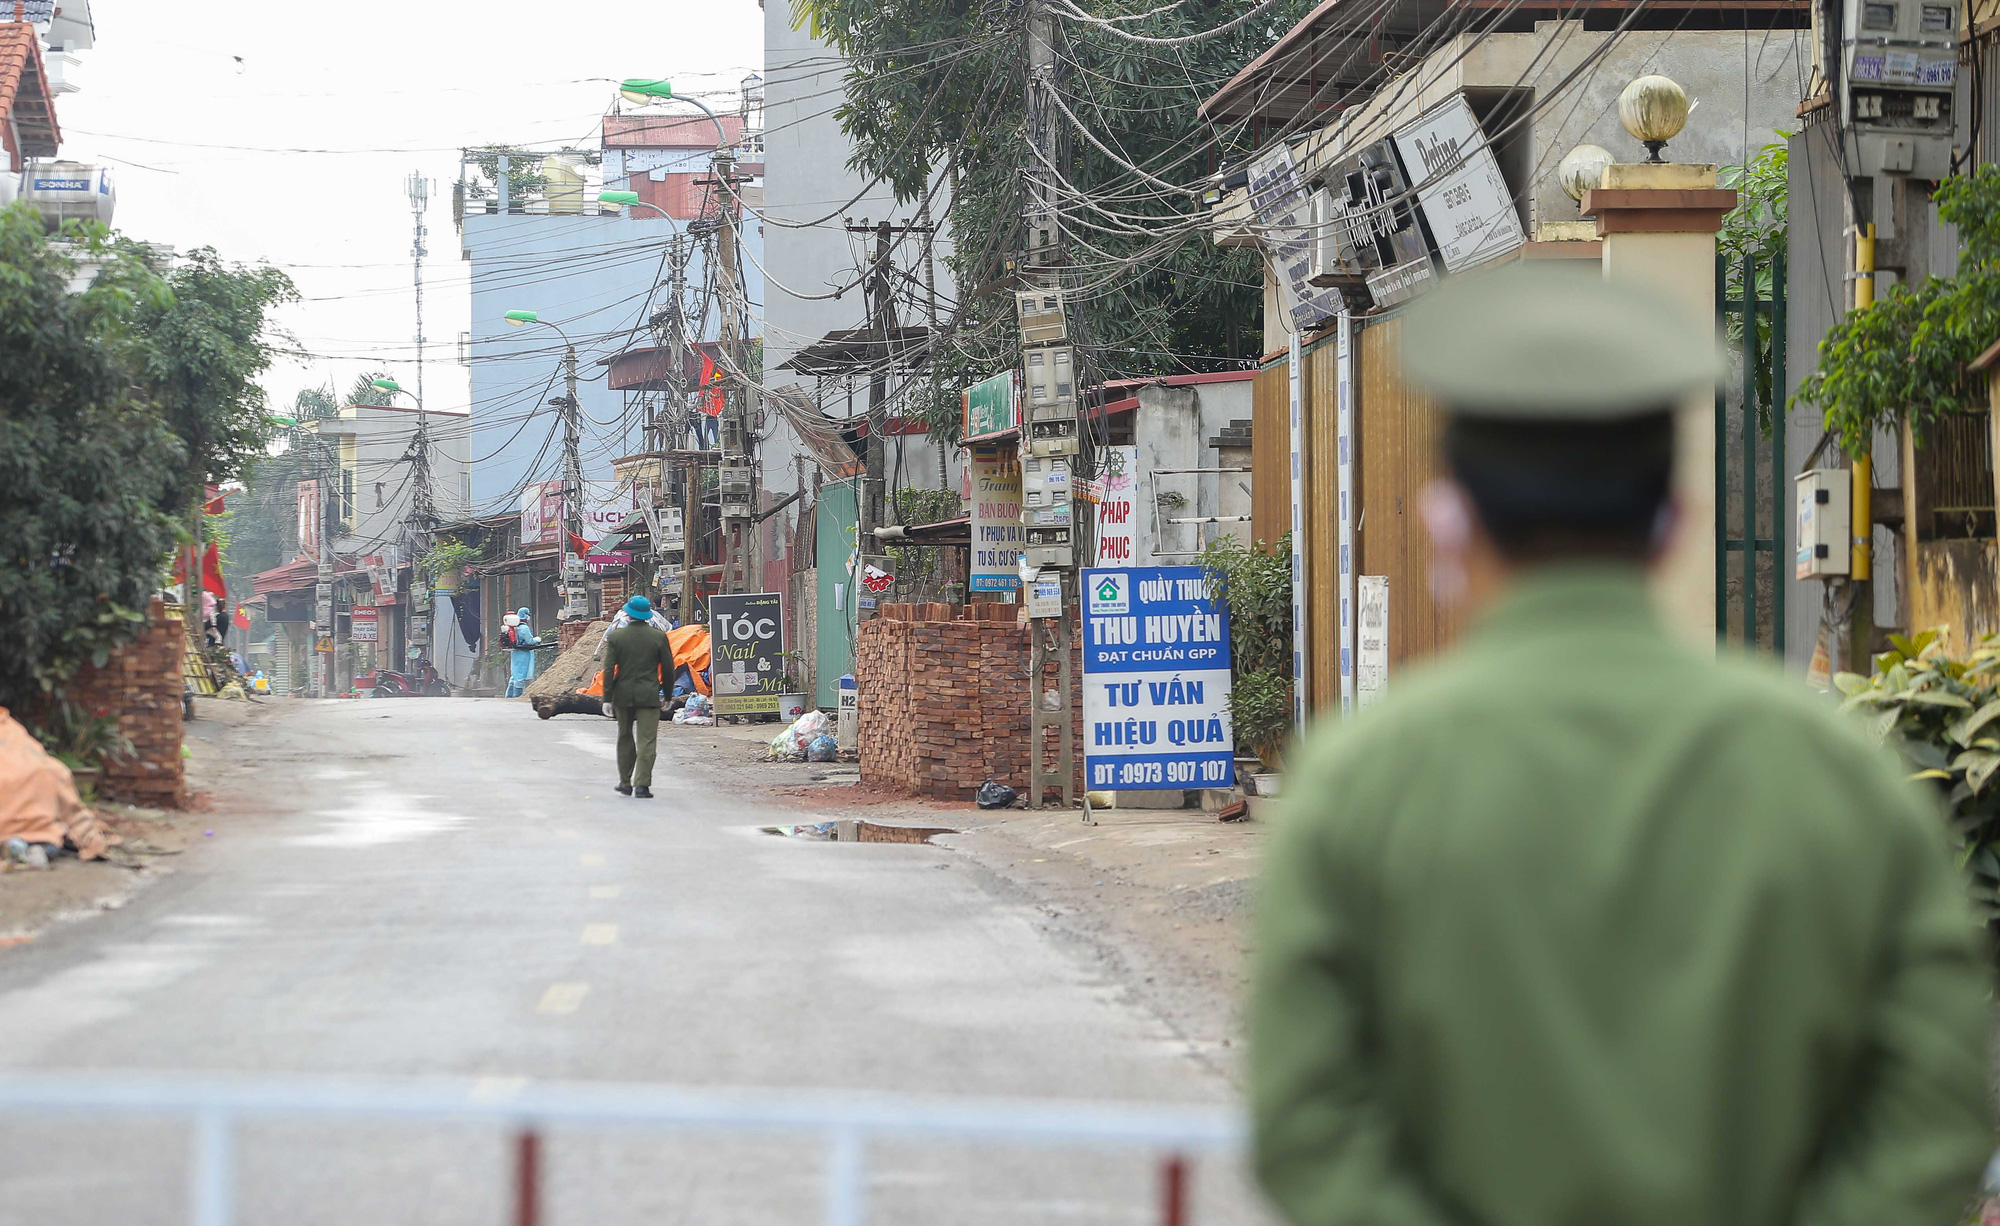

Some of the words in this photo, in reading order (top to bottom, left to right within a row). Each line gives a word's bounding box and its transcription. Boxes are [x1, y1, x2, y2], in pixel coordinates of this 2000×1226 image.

[978, 499, 996, 518] BÁN
[1100, 496, 1130, 524] PHÁP
[986, 525, 1006, 545] PHỤC
[1007, 523, 1017, 541] VÀ
[1100, 536, 1130, 564] PHỤC
[1139, 573, 1173, 604] QUẦY
[1090, 616, 1138, 645] THU
[1145, 605, 1221, 644] HUYỀN
[716, 641, 759, 661] Nail
[1097, 651, 1128, 664] ĐẠT
[1131, 646, 1184, 661] CHUẨN
[1188, 648, 1217, 659] GPP
[757, 657, 771, 671] &
[841, 695, 856, 707] H2
[1104, 679, 1142, 707] TƯ
[1148, 673, 1204, 706] VẤN
[1094, 717, 1156, 749] HIỆU
[1167, 713, 1224, 746] QUẢ
[1094, 764, 1115, 784] ĐT
[1167, 761, 1196, 782] 907
[1200, 760, 1227, 782] 107
